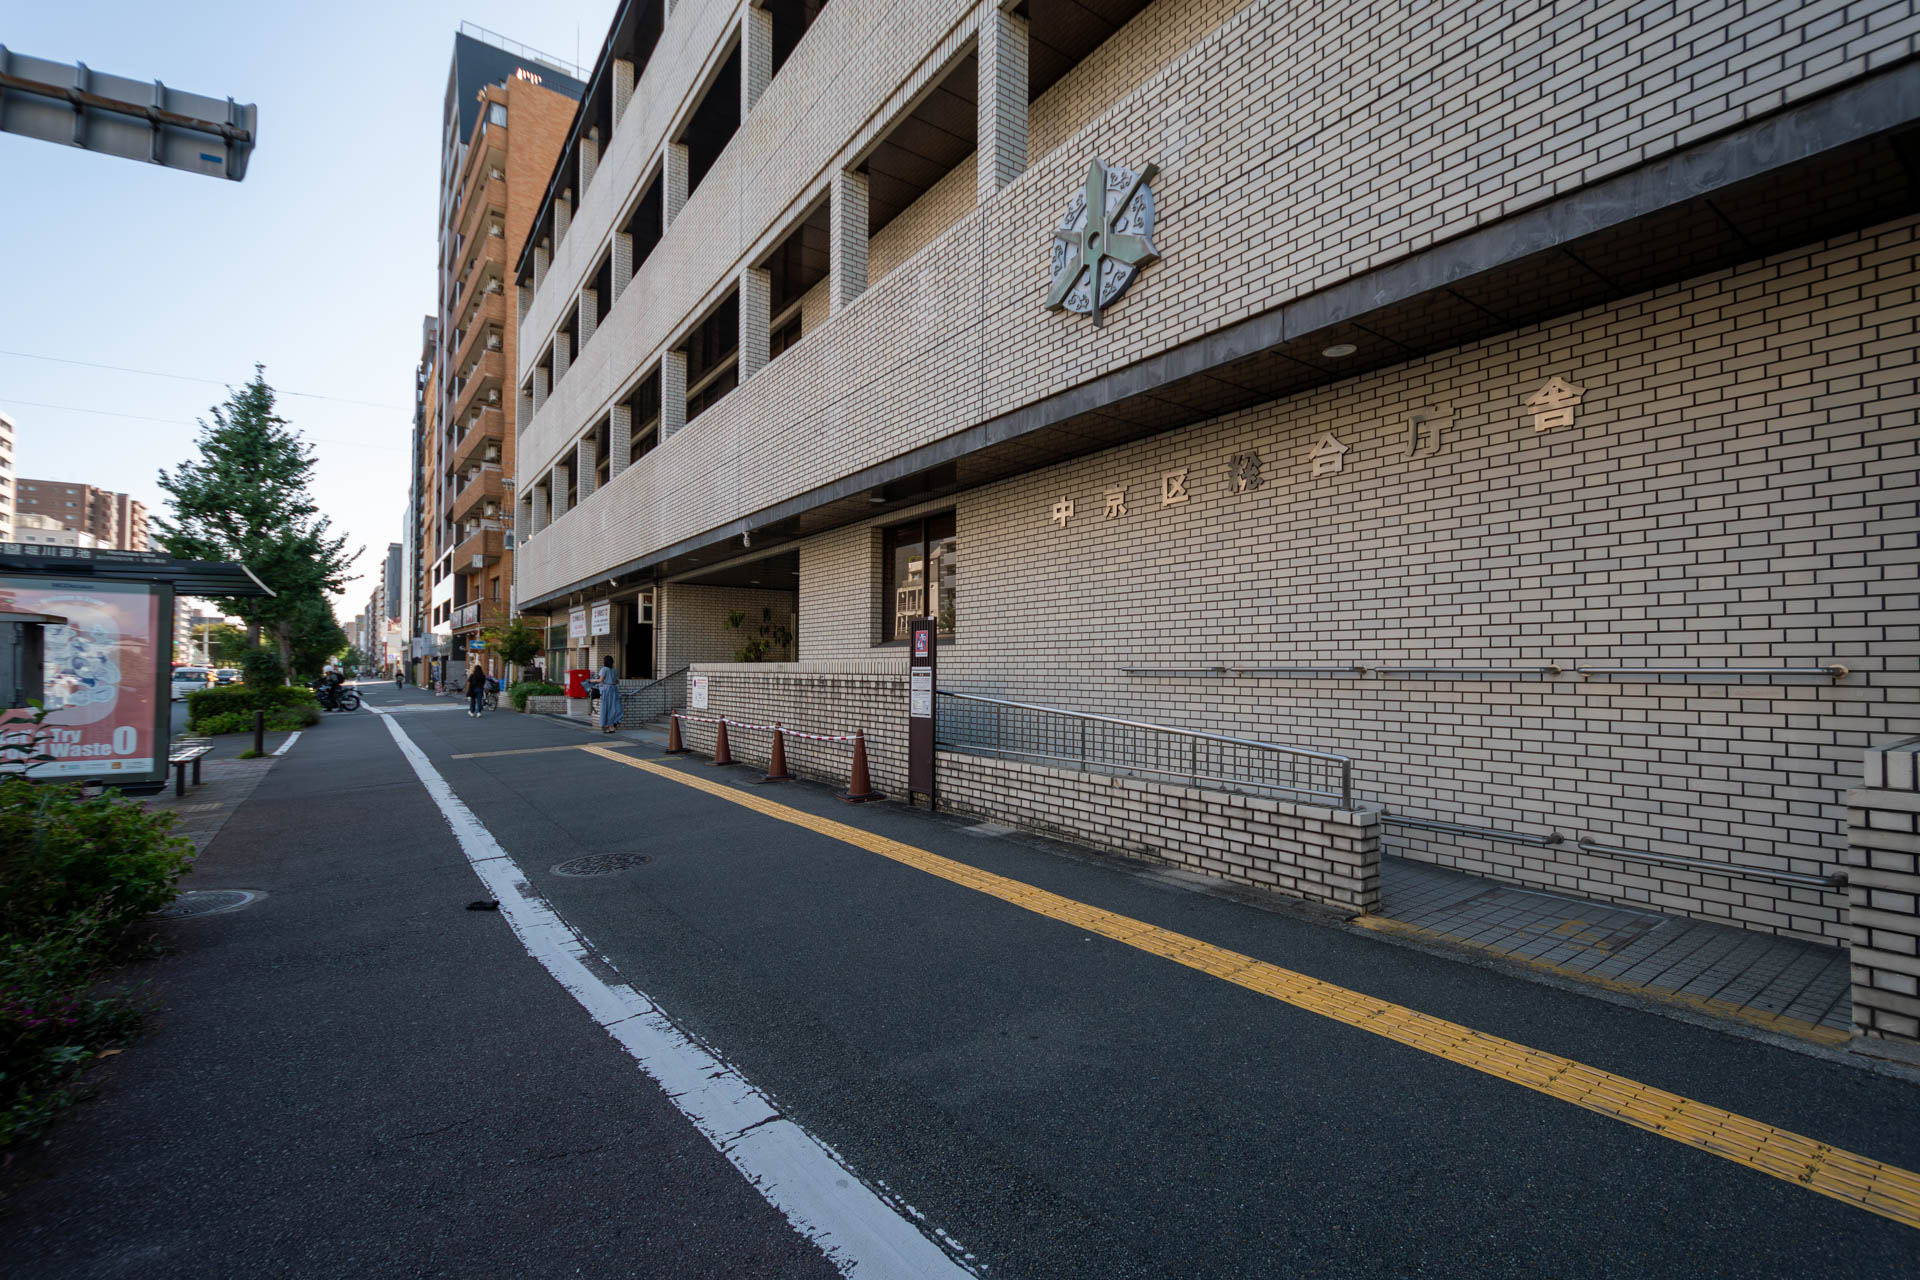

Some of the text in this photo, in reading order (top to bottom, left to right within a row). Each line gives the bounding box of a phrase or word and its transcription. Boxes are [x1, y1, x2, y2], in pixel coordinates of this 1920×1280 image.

[1052, 376, 1588, 528] 中京区総合庁舎
[49, 743, 112, 757] Waste
[113, 726, 137, 755] 0
[51, 728, 82, 744] Try
